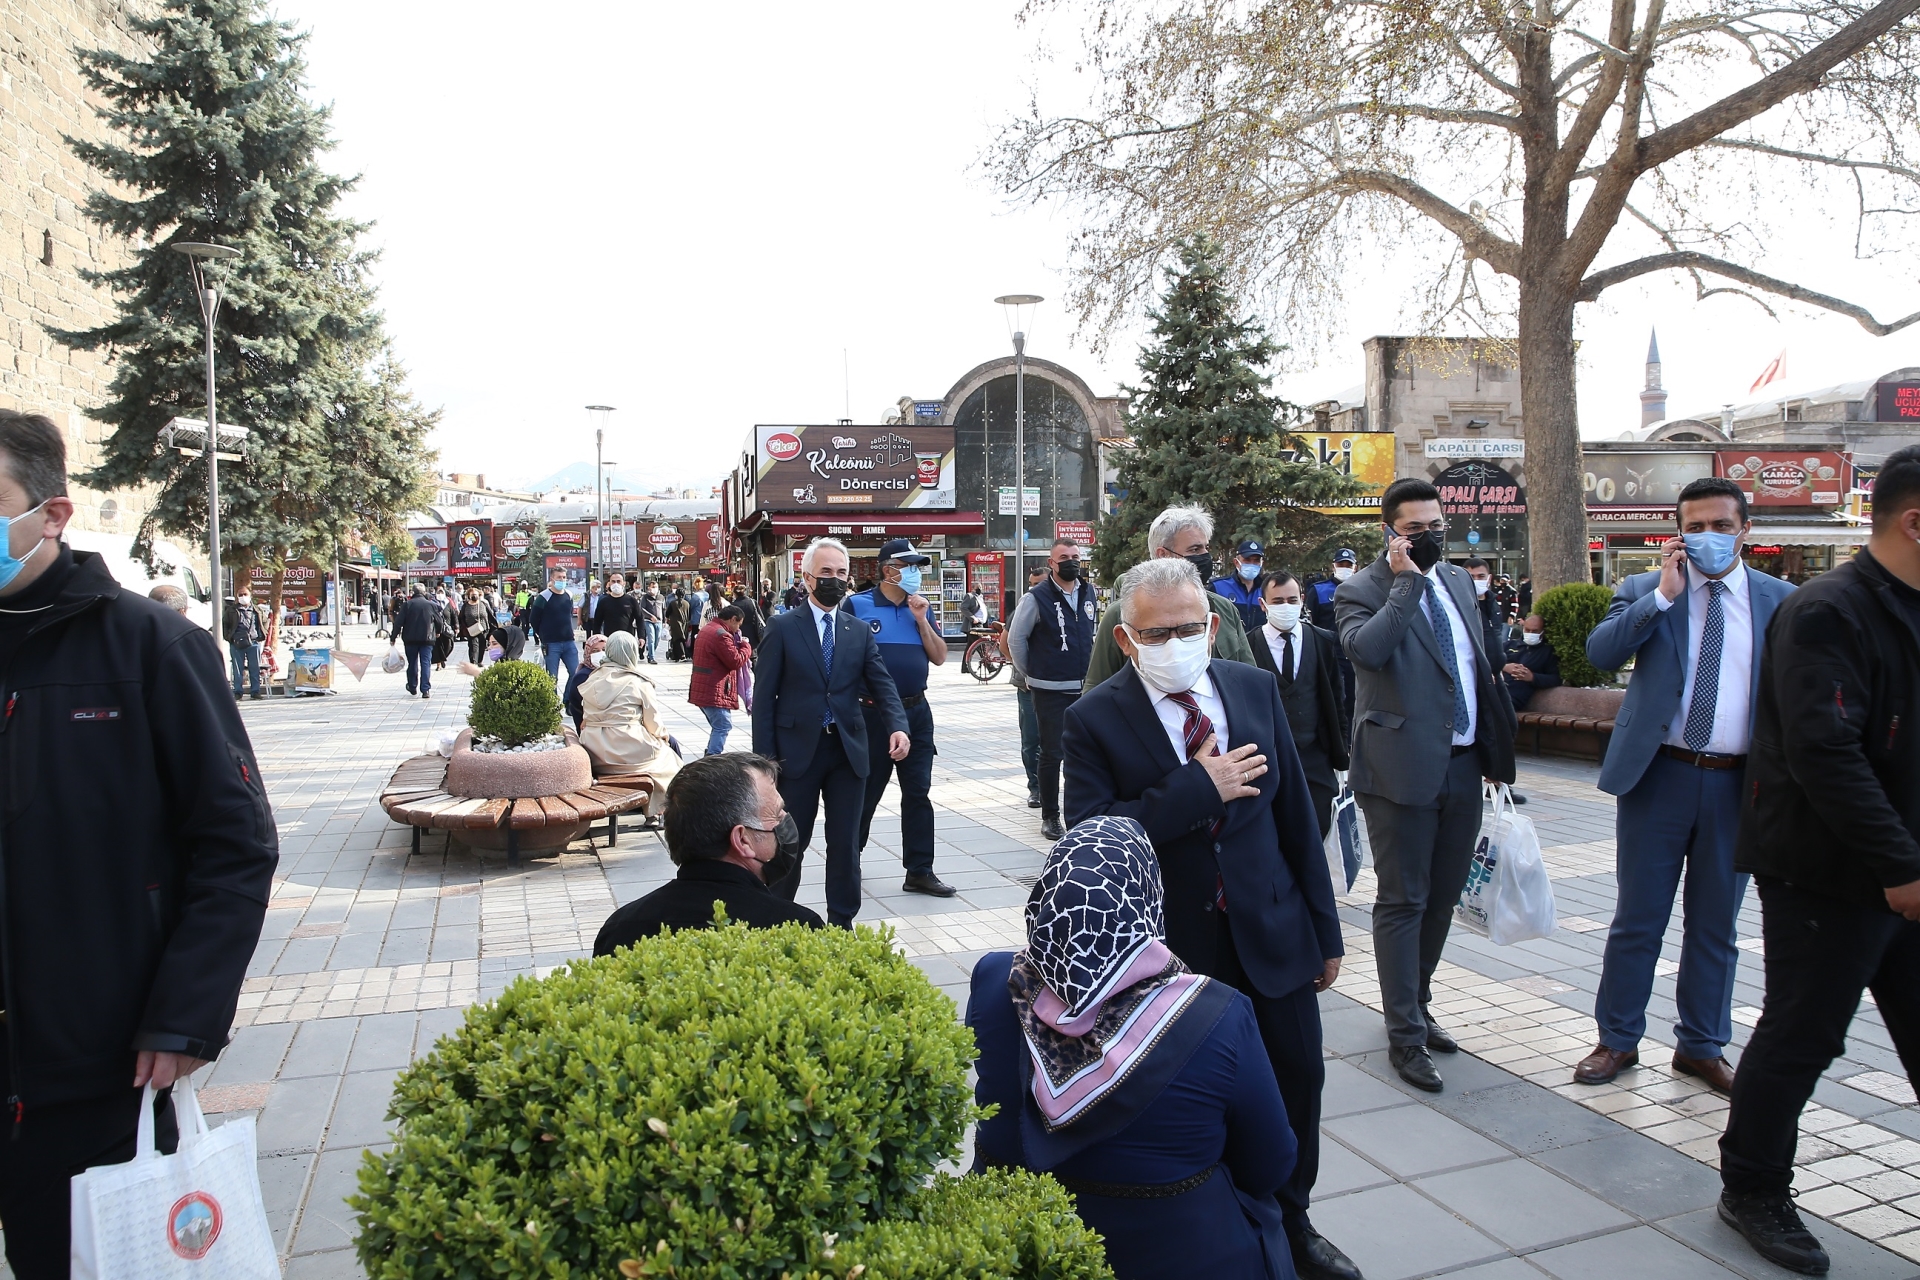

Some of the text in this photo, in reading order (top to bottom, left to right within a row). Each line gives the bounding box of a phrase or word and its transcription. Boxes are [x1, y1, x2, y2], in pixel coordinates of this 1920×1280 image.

[1897, 388, 1920, 397] MEY
[833, 437, 857, 448] Tarihi
[1428, 444, 1477, 452] KAPALI
[806, 449, 875, 479] Kaleönü
[1479, 486, 1517, 504] ÇARŞI
[828, 526, 886, 534] SUCUK EKMEK
[649, 556, 685, 564] KANAAT
[1053, 601, 1069, 652] ZABITA
